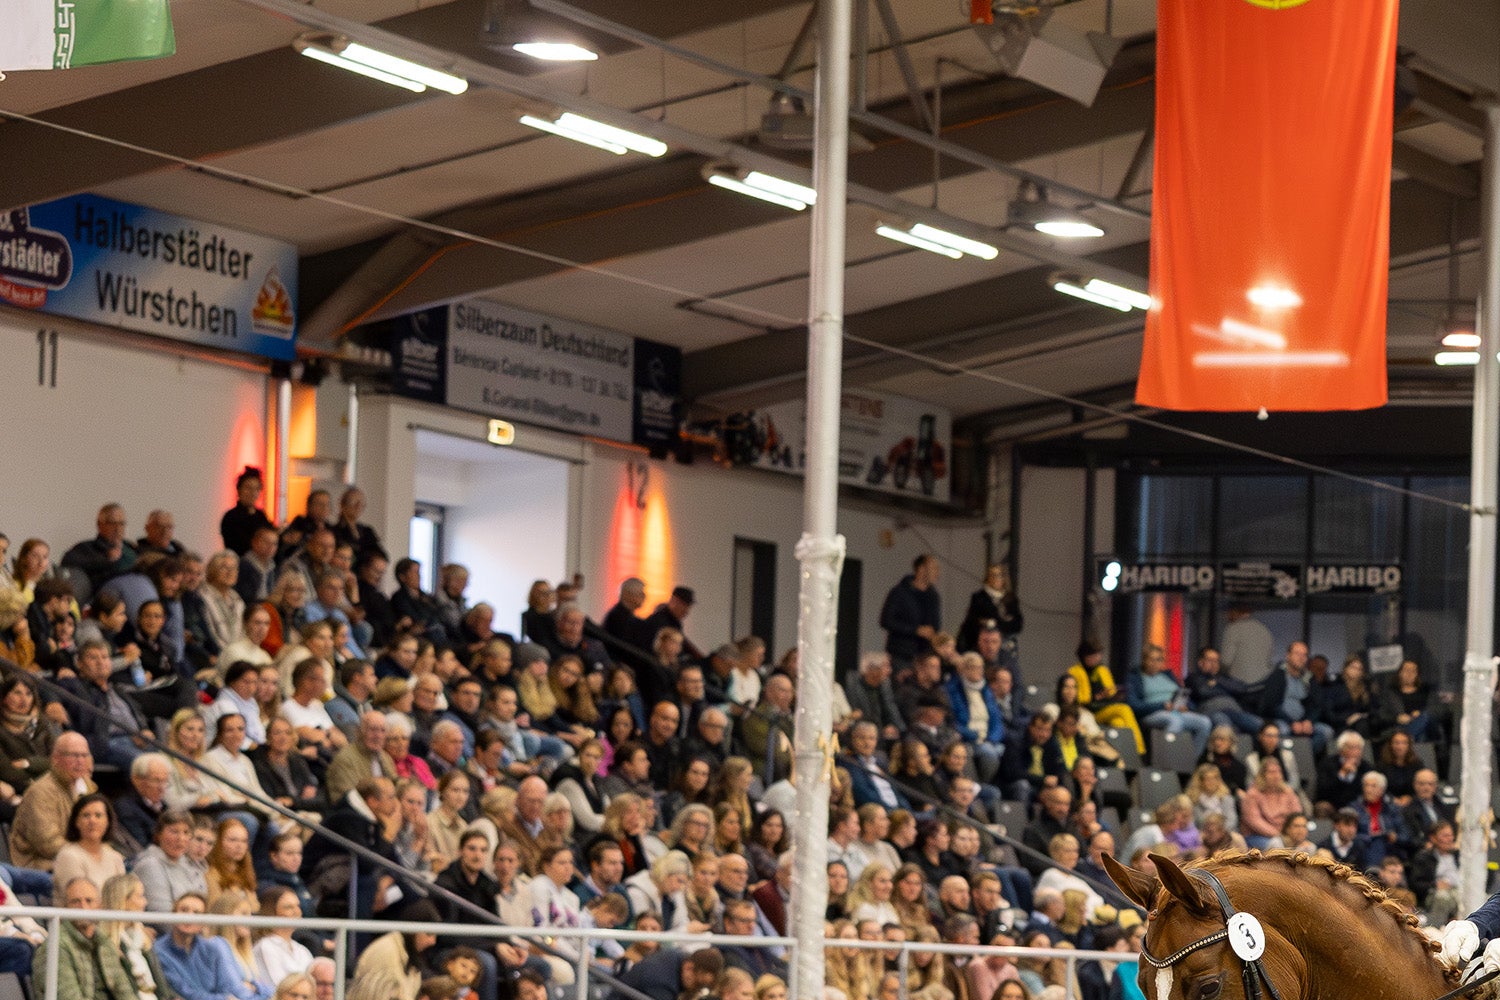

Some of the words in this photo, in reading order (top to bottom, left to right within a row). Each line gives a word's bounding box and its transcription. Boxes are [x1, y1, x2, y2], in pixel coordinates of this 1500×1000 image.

[74, 203, 254, 281] Halberstädter
[96, 269, 238, 338] Würstchen
[455, 302, 538, 346] Silberzaun
[541, 322, 629, 368] Deutschland
[1122, 565, 1215, 586] HARIBO
[1306, 565, 1401, 586] HARIBO
[1238, 922, 1256, 949] 3
